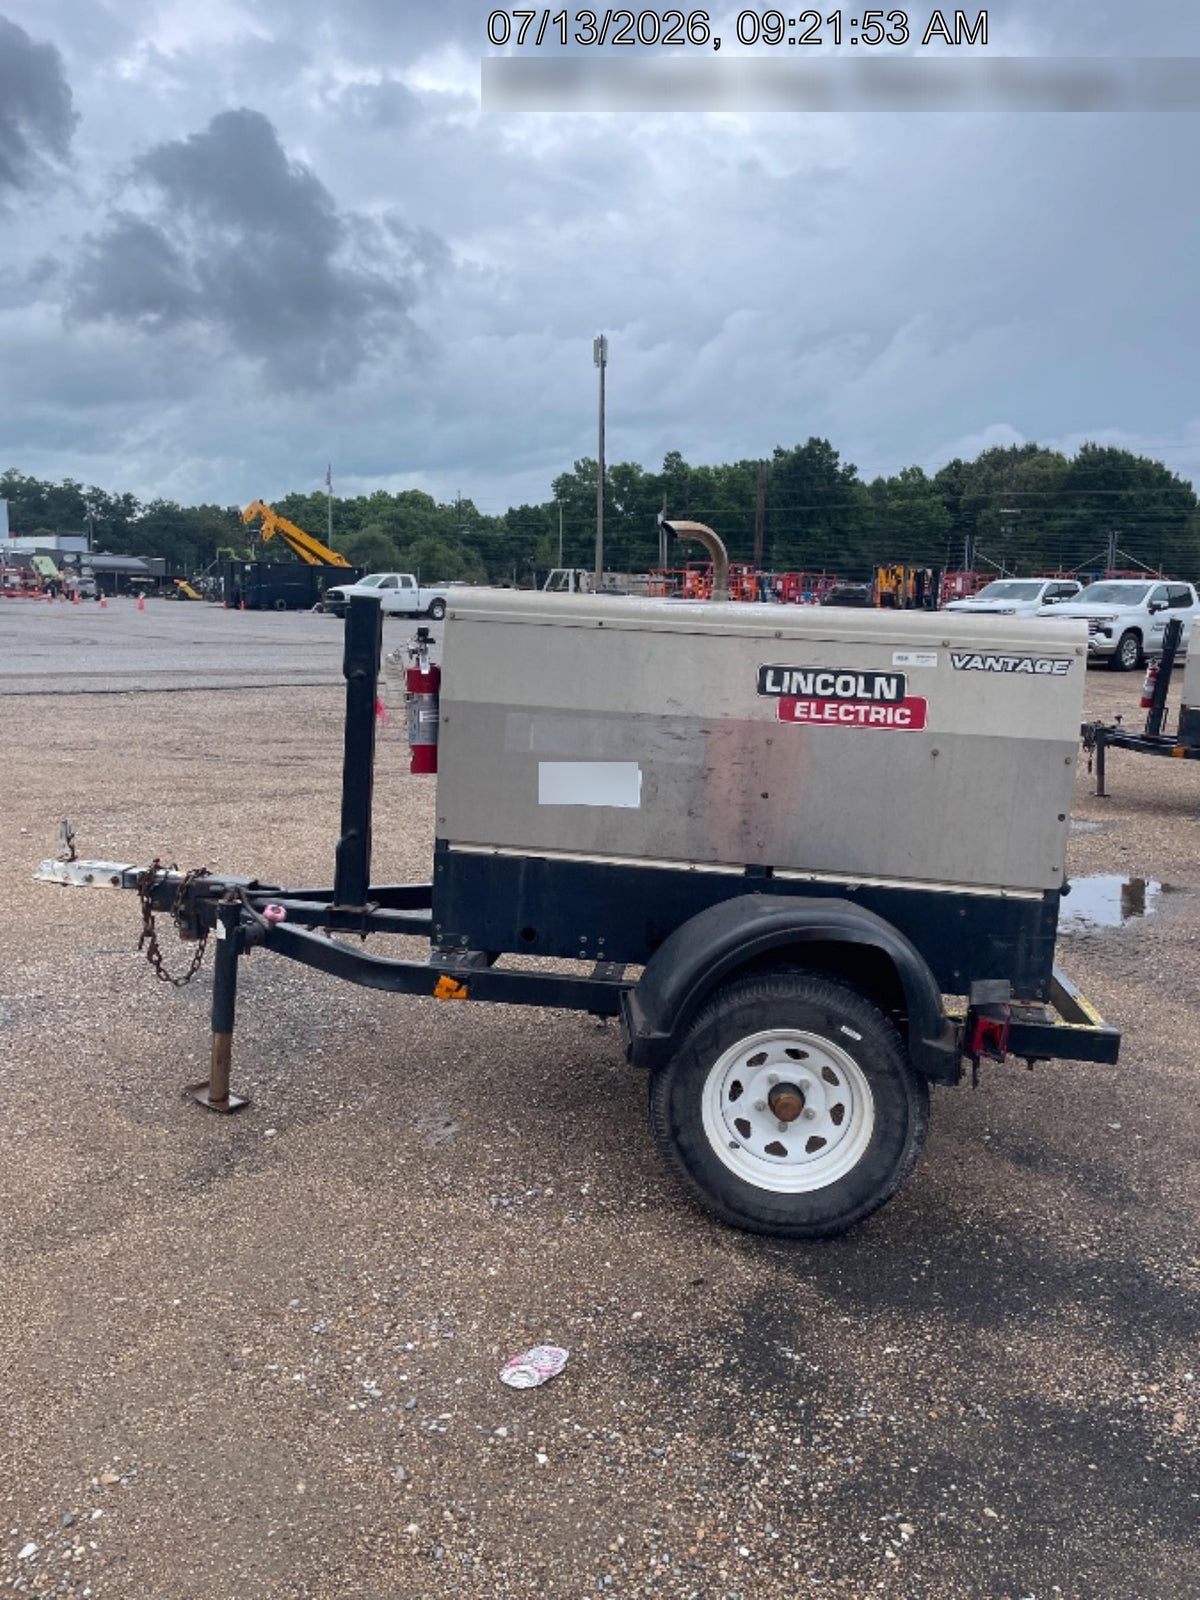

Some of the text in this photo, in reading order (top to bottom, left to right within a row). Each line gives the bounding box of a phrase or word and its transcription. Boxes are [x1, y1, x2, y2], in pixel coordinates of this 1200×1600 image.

[951, 653, 1072, 676] VANTAGE
[765, 669, 898, 700] LINCOLN
[794, 702, 911, 725] ELECTRIC
